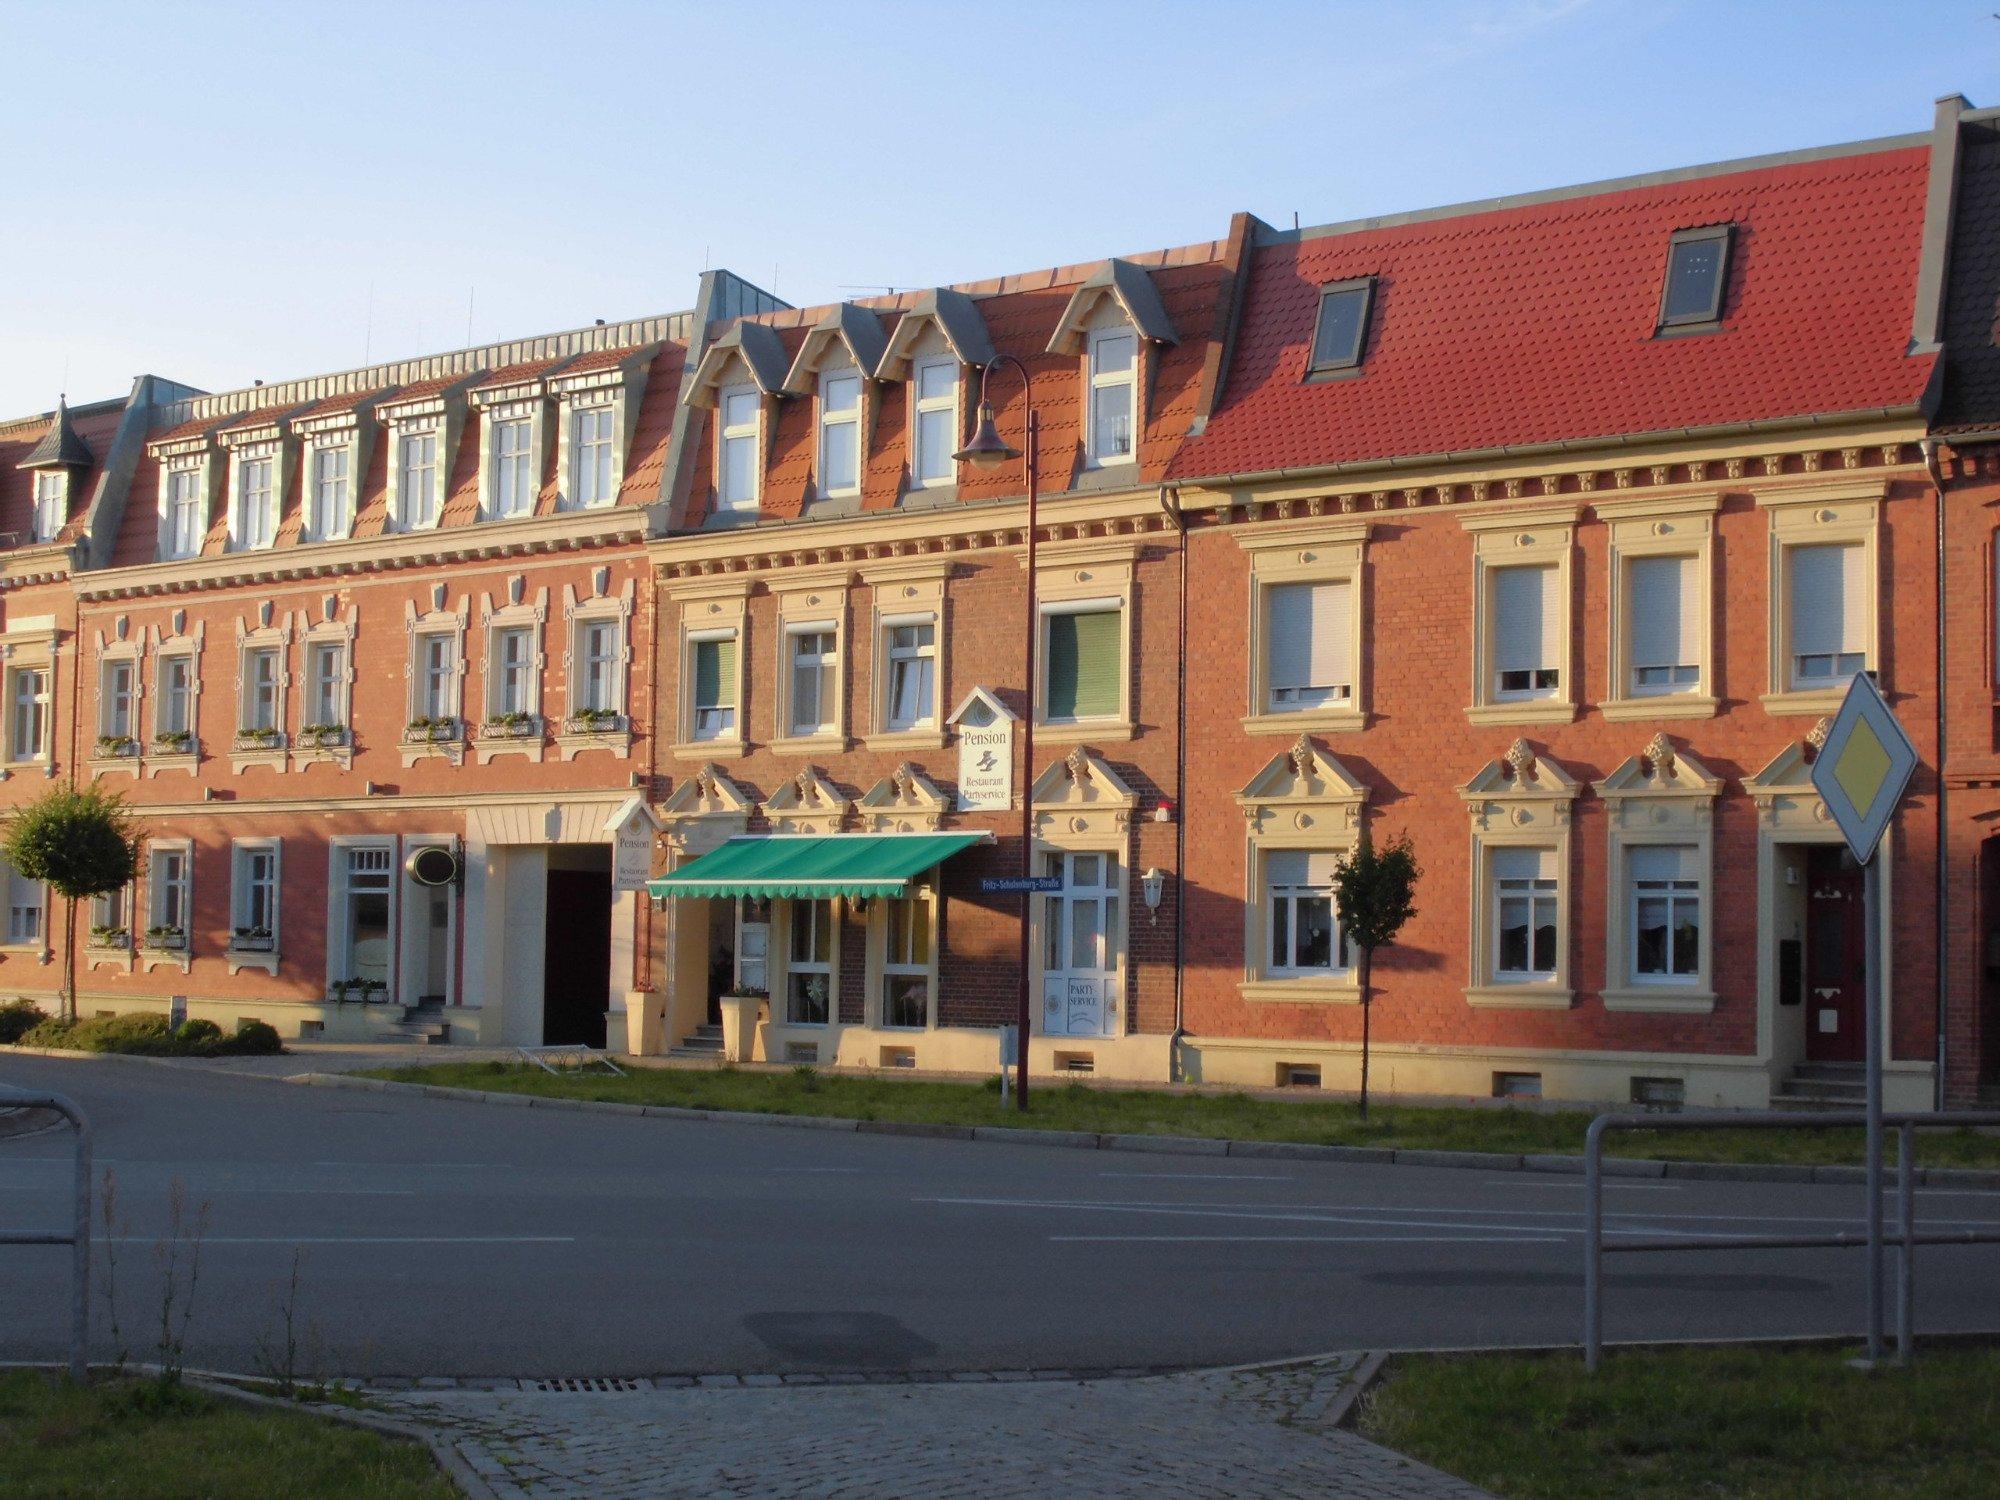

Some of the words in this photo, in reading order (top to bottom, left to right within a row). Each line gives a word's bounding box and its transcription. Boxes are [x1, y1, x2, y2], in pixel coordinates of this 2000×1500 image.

[964, 731, 1006, 745] Pension
[966, 777, 1004, 786] Restaurant
[963, 790, 1006, 801] Partyservice
[620, 838, 649, 848] Pension
